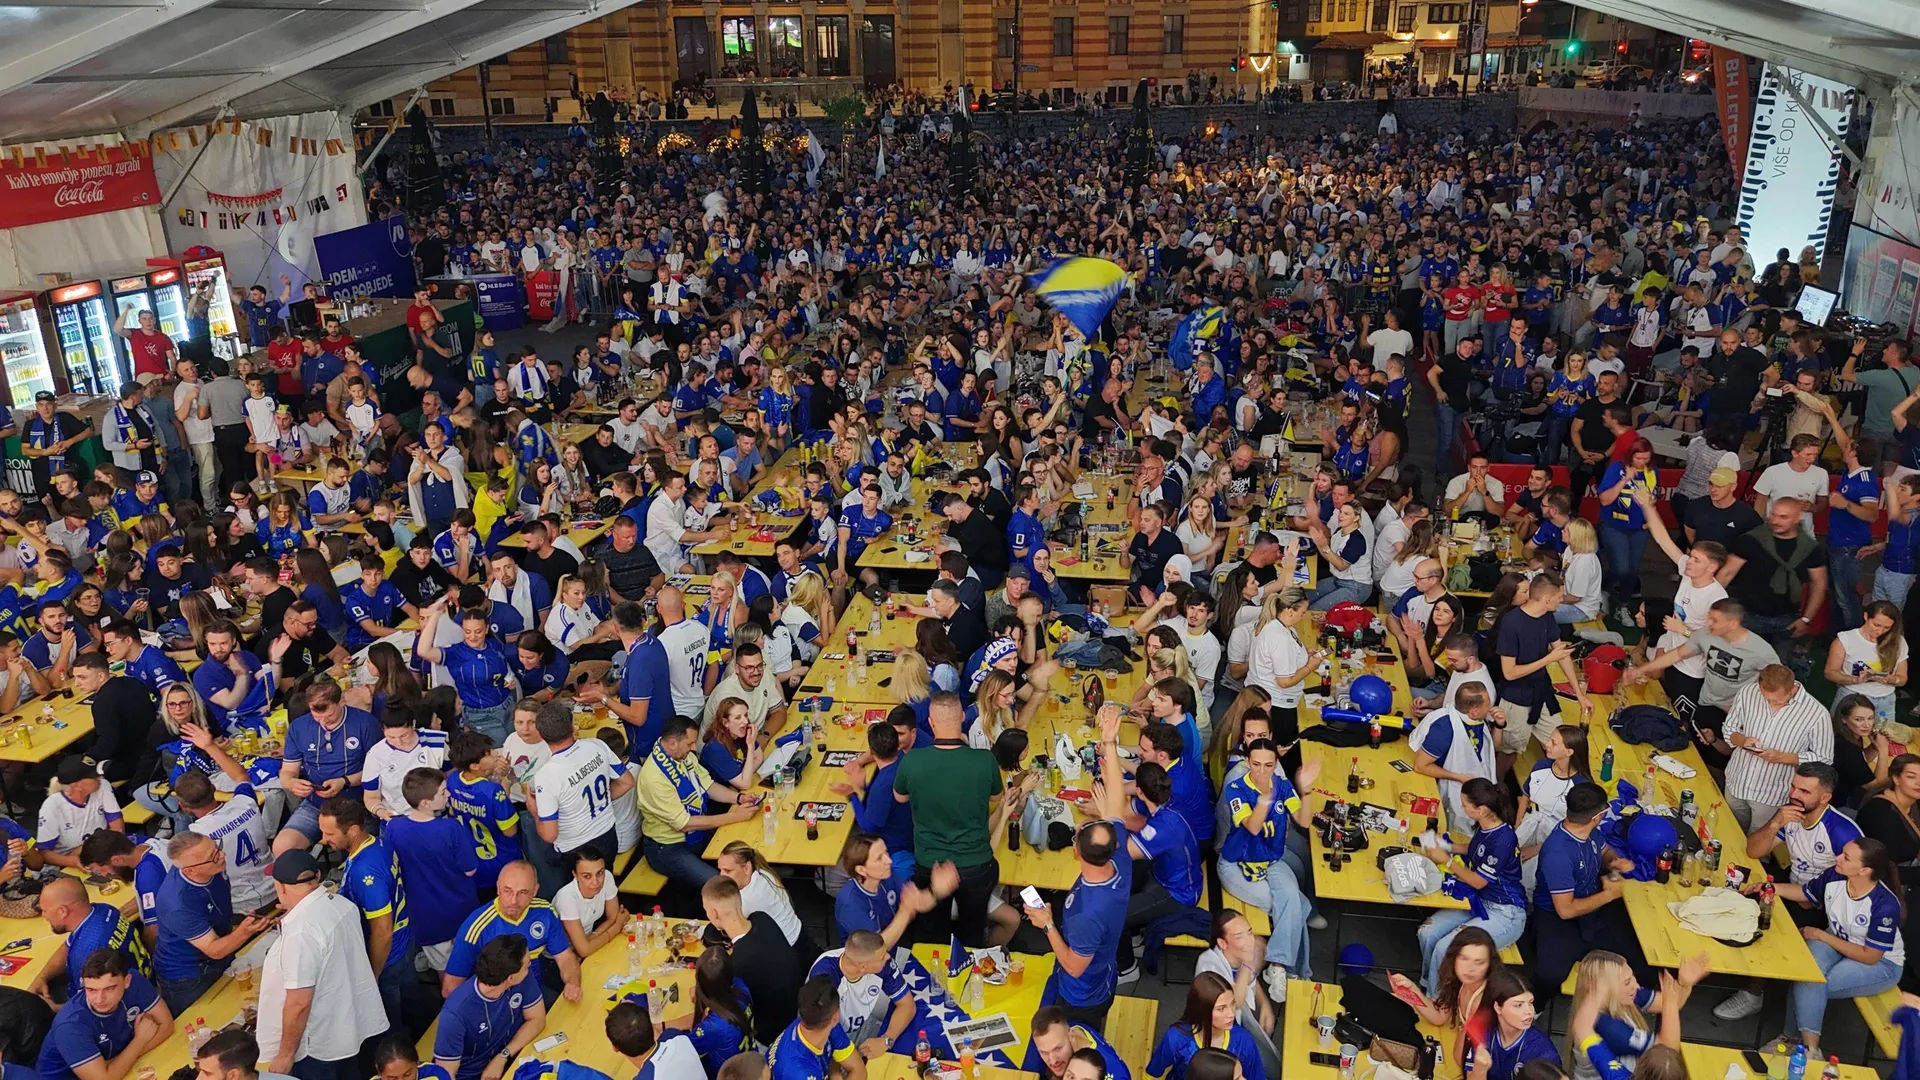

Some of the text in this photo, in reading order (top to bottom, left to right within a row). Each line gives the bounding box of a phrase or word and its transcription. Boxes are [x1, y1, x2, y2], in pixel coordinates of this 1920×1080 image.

[1780, 117, 1796, 141] OD
[5, 171, 29, 190] Kad
[29, 173, 41, 187] te
[41, 167, 80, 186] emocije
[115, 156, 141, 177] zgrabi
[1772, 147, 1791, 178] VIŠE
[352, 273, 395, 300] POBJEDE
[6, 458, 32, 470] ROM
[688, 652, 705, 689] 19
[567, 752, 605, 788] ALAJBEGOVIĆ
[582, 774, 610, 820] 19
[1262, 820, 1275, 839] 11
[234, 828, 260, 868] 4
[846, 1015, 865, 1035] 19
